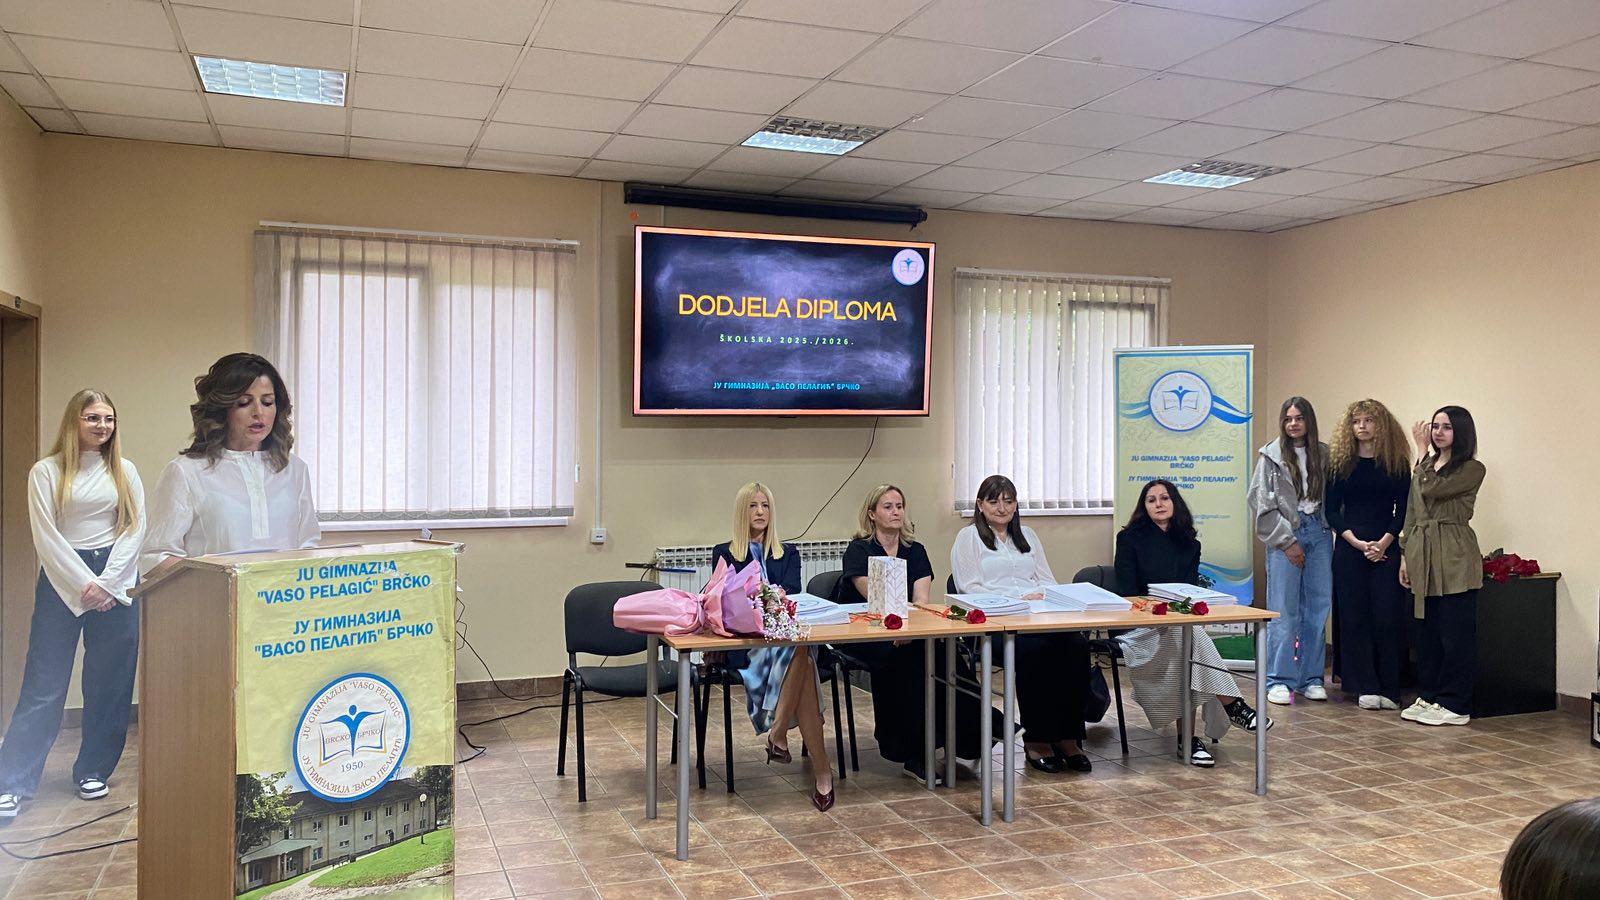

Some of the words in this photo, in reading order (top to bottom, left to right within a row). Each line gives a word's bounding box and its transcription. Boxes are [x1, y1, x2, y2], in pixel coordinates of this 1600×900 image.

[678, 293, 791, 318] DODJELA
[796, 298, 897, 322] DIPLOMA
[719, 333, 772, 344] ŠKOLSKA
[779, 336, 854, 346] 2025./2026.
[723, 382, 769, 390] ГИМНАЗИЈА
[1170, 461, 1194, 469] BRČKO
[296, 567, 314, 581] JU
[257, 587, 305, 604] "VASO
[310, 577, 379, 599] PELAGIĆ"
[382, 573, 431, 591] BRČKO
[293, 620, 310, 635] ЈУ
[314, 608, 402, 632] ГИМНАЗИЈА
[254, 639, 306, 659] "ВАСО
[310, 628, 384, 651] ПЕЛАГИЋ"
[387, 622, 434, 640] БРЧКО
[309, 684, 348, 723] GIMNAZIJA
[307, 766, 350, 793] ГИМНАЗИЈА
[340, 761, 366, 773] 1950.
